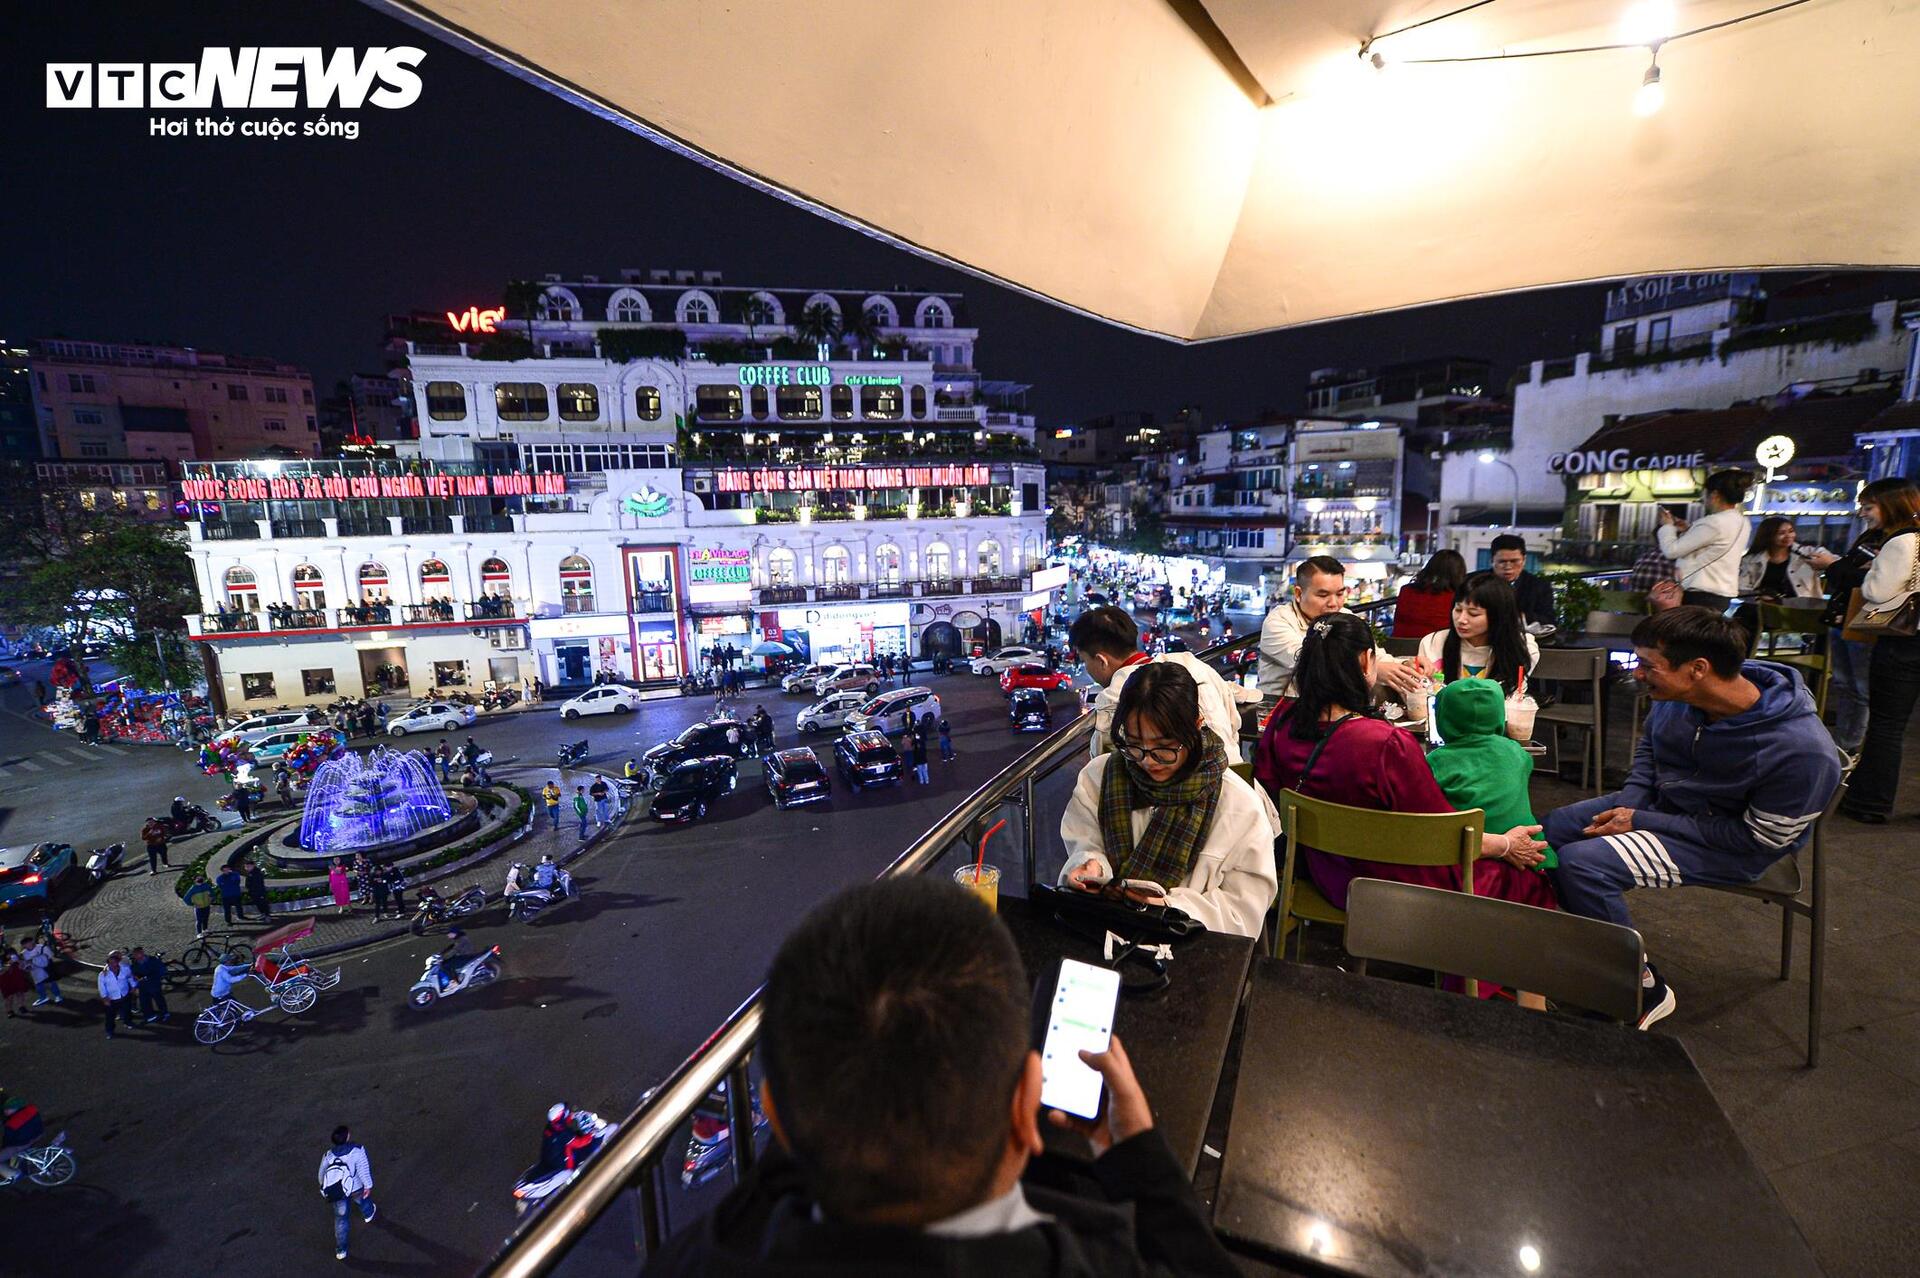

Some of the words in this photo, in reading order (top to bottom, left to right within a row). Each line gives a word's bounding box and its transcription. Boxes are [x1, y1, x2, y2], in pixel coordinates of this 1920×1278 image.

[739, 366, 789, 386] COFFEE
[796, 366, 831, 385] CLUB
[228, 474, 268, 503] CỘNG
[303, 473, 324, 499] XÃ
[325, 470, 349, 502] HỘI
[351, 470, 380, 498] CHỦ
[426, 471, 455, 500] VIỆT
[456, 474, 488, 496] NAM
[493, 470, 532, 495] MUÔN
[535, 470, 565, 494] NĂM
[718, 466, 750, 492] ĐẢNG
[753, 467, 785, 495] CỘNG
[788, 465, 812, 489] SẢN
[813, 466, 838, 492] VIỆT
[839, 469, 866, 489] NAM
[867, 468, 903, 490] QUANG
[905, 468, 931, 487] VINH
[932, 463, 963, 487] MUÔN
[965, 463, 990, 485] NĂM
